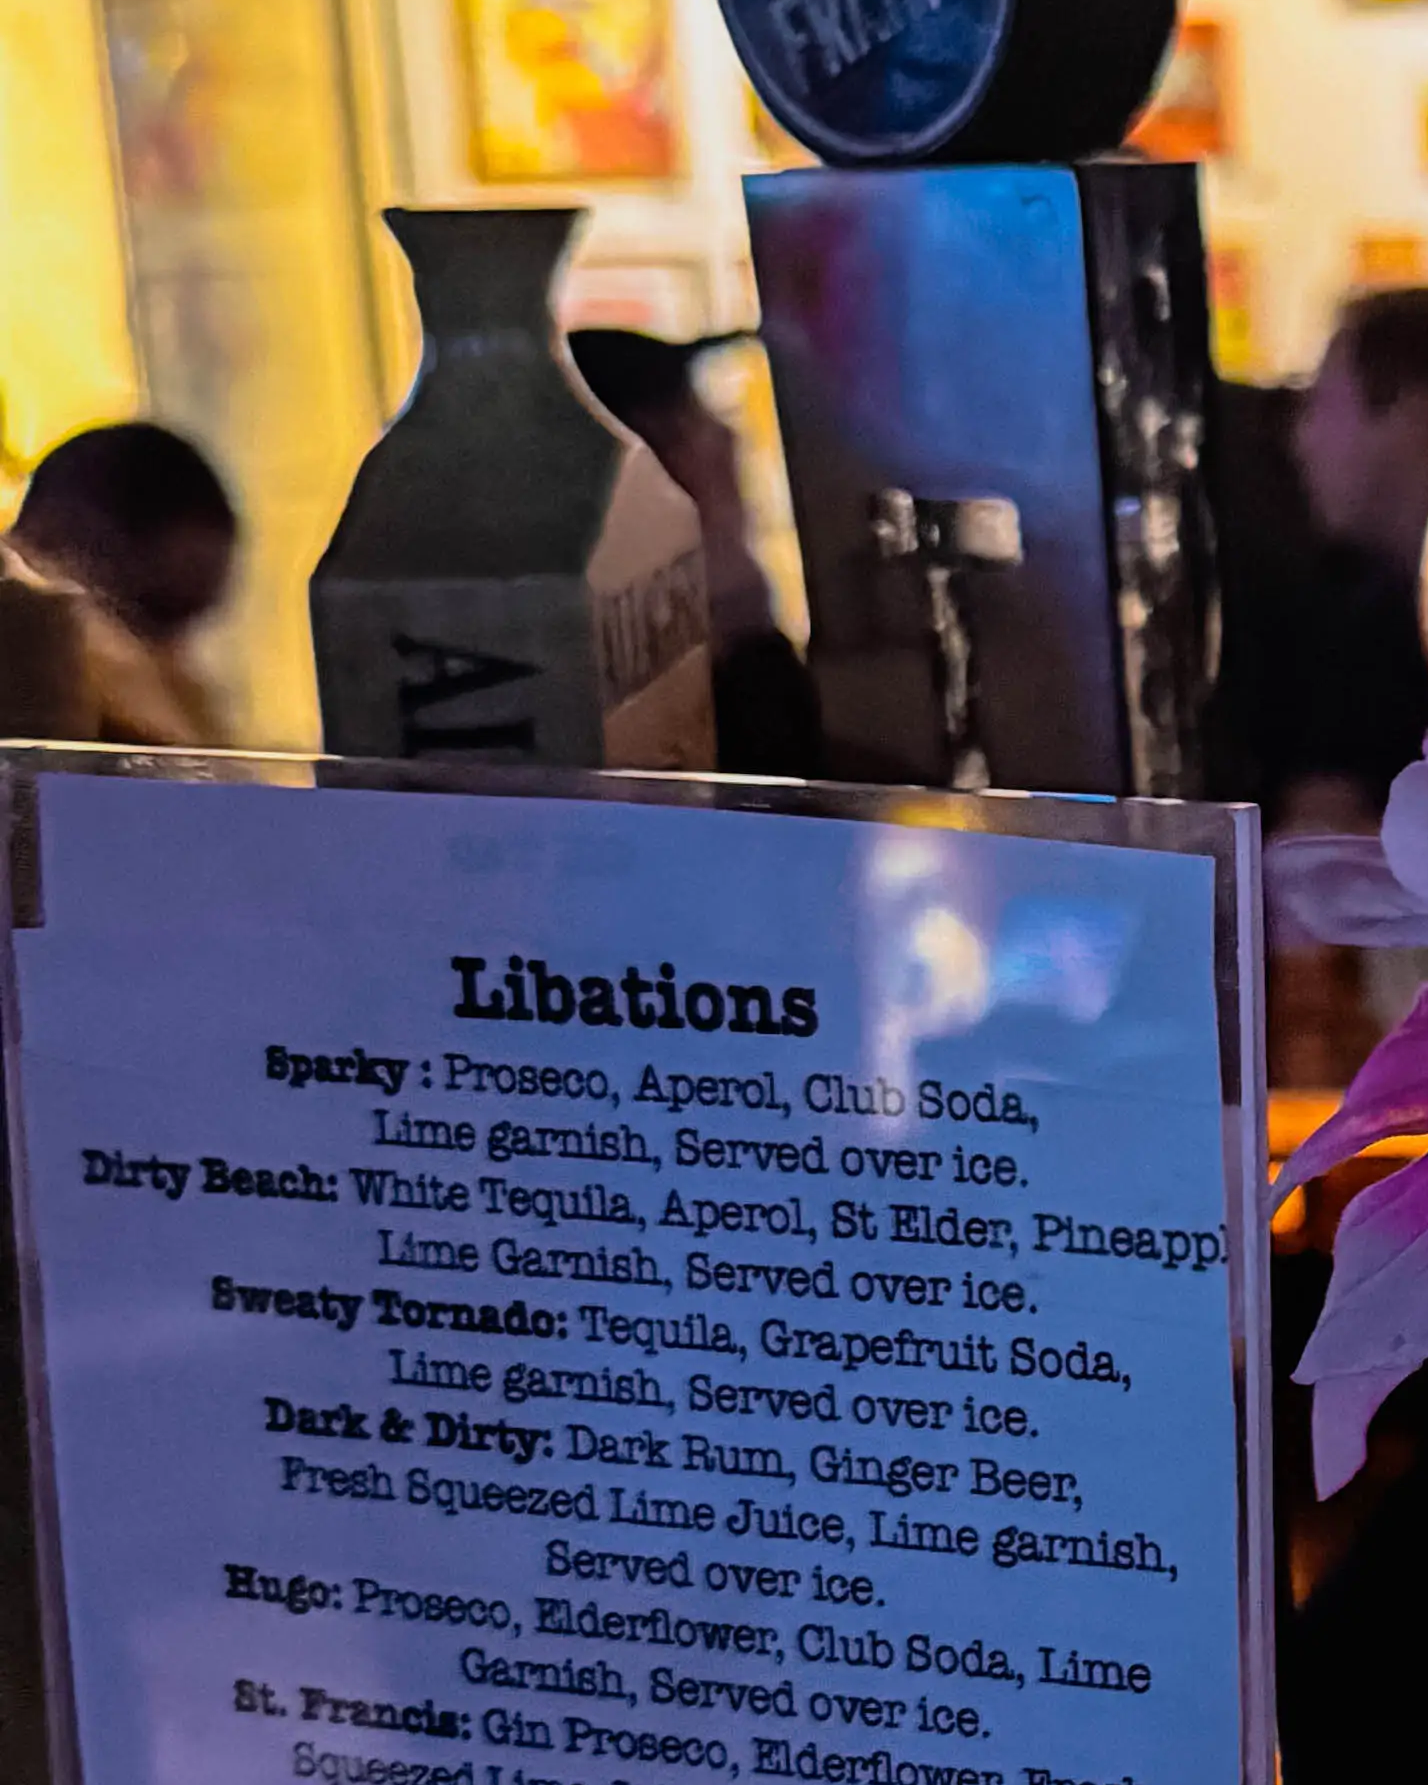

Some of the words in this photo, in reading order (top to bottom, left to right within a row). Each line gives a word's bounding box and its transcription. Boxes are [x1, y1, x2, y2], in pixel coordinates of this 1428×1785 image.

[449, 954, 819, 1038] Libations
[442, 1052, 621, 1109] Proseco,
[632, 1063, 792, 1119] Aperol,
[802, 1072, 904, 1116] Club
[917, 1078, 1040, 1135] Soda,
[372, 1108, 476, 1152] Lime
[486, 1120, 662, 1173] garnish,
[674, 1127, 830, 1175] Served
[840, 1146, 943, 1181] over
[951, 1144, 1029, 1188] ice.
[80, 1148, 192, 1201] Dirty
[198, 1156, 339, 1203] Beach:
[348, 1167, 471, 1213] White
[477, 1176, 647, 1233] Tequila,
[657, 1188, 817, 1245] Aperol,
[830, 1199, 878, 1241] St
[888, 1203, 1019, 1259] Elder,
[377, 1228, 480, 1273] Lime
[491, 1237, 673, 1295] Garnish,
[686, 1251, 840, 1299] Served
[849, 1271, 952, 1307] over
[961, 1271, 1038, 1315] ice.
[210, 1274, 365, 1333] Sweaty
[370, 1288, 568, 1340] Tornado:
[577, 1304, 748, 1363] Tequila,
[760, 1318, 998, 1374] Grapefruit
[1010, 1336, 1132, 1393] Soda,
[387, 1348, 492, 1393] Lime
[502, 1362, 676, 1416] garnish,
[687, 1373, 842, 1423] Served
[851, 1394, 954, 1431] over
[962, 1395, 1040, 1439] ice.
[262, 1396, 372, 1440] Dark
[379, 1407, 415, 1444] &
[423, 1411, 554, 1465] Dirty:
[565, 1423, 673, 1469] Dark
[680, 1433, 797, 1488] Rum,
[809, 1444, 960, 1498] Ginger
[969, 1457, 1083, 1513] Beer,
[280, 1455, 397, 1501] Fresh
[406, 1467, 600, 1522] Squeezed
[608, 1487, 716, 1533] Lime
[725, 1498, 856, 1554] Juice,
[868, 1509, 980, 1558] Lime
[991, 1525, 1178, 1583] garnish,
[545, 1538, 695, 1589] Served
[704, 1562, 802, 1598] over
[811, 1564, 886, 1608] ice.
[222, 1563, 343, 1615] Hugo:
[351, 1577, 522, 1639] Proseco,
[533, 1597, 785, 1666] Elderflower,
[796, 1623, 895, 1670] Club
[906, 1633, 1026, 1691] Soda,
[1037, 1646, 1152, 1695] Lime
[232, 1678, 288, 1718] St.
[298, 1686, 472, 1741] Francis:
[481, 1708, 555, 1750] Gin
[562, 1716, 740, 1780] Proseco,
[459, 1646, 638, 1708] Garnish,
[649, 1666, 799, 1718] Served
[808, 1692, 907, 1729] over
[916, 1696, 991, 1739] ice.
